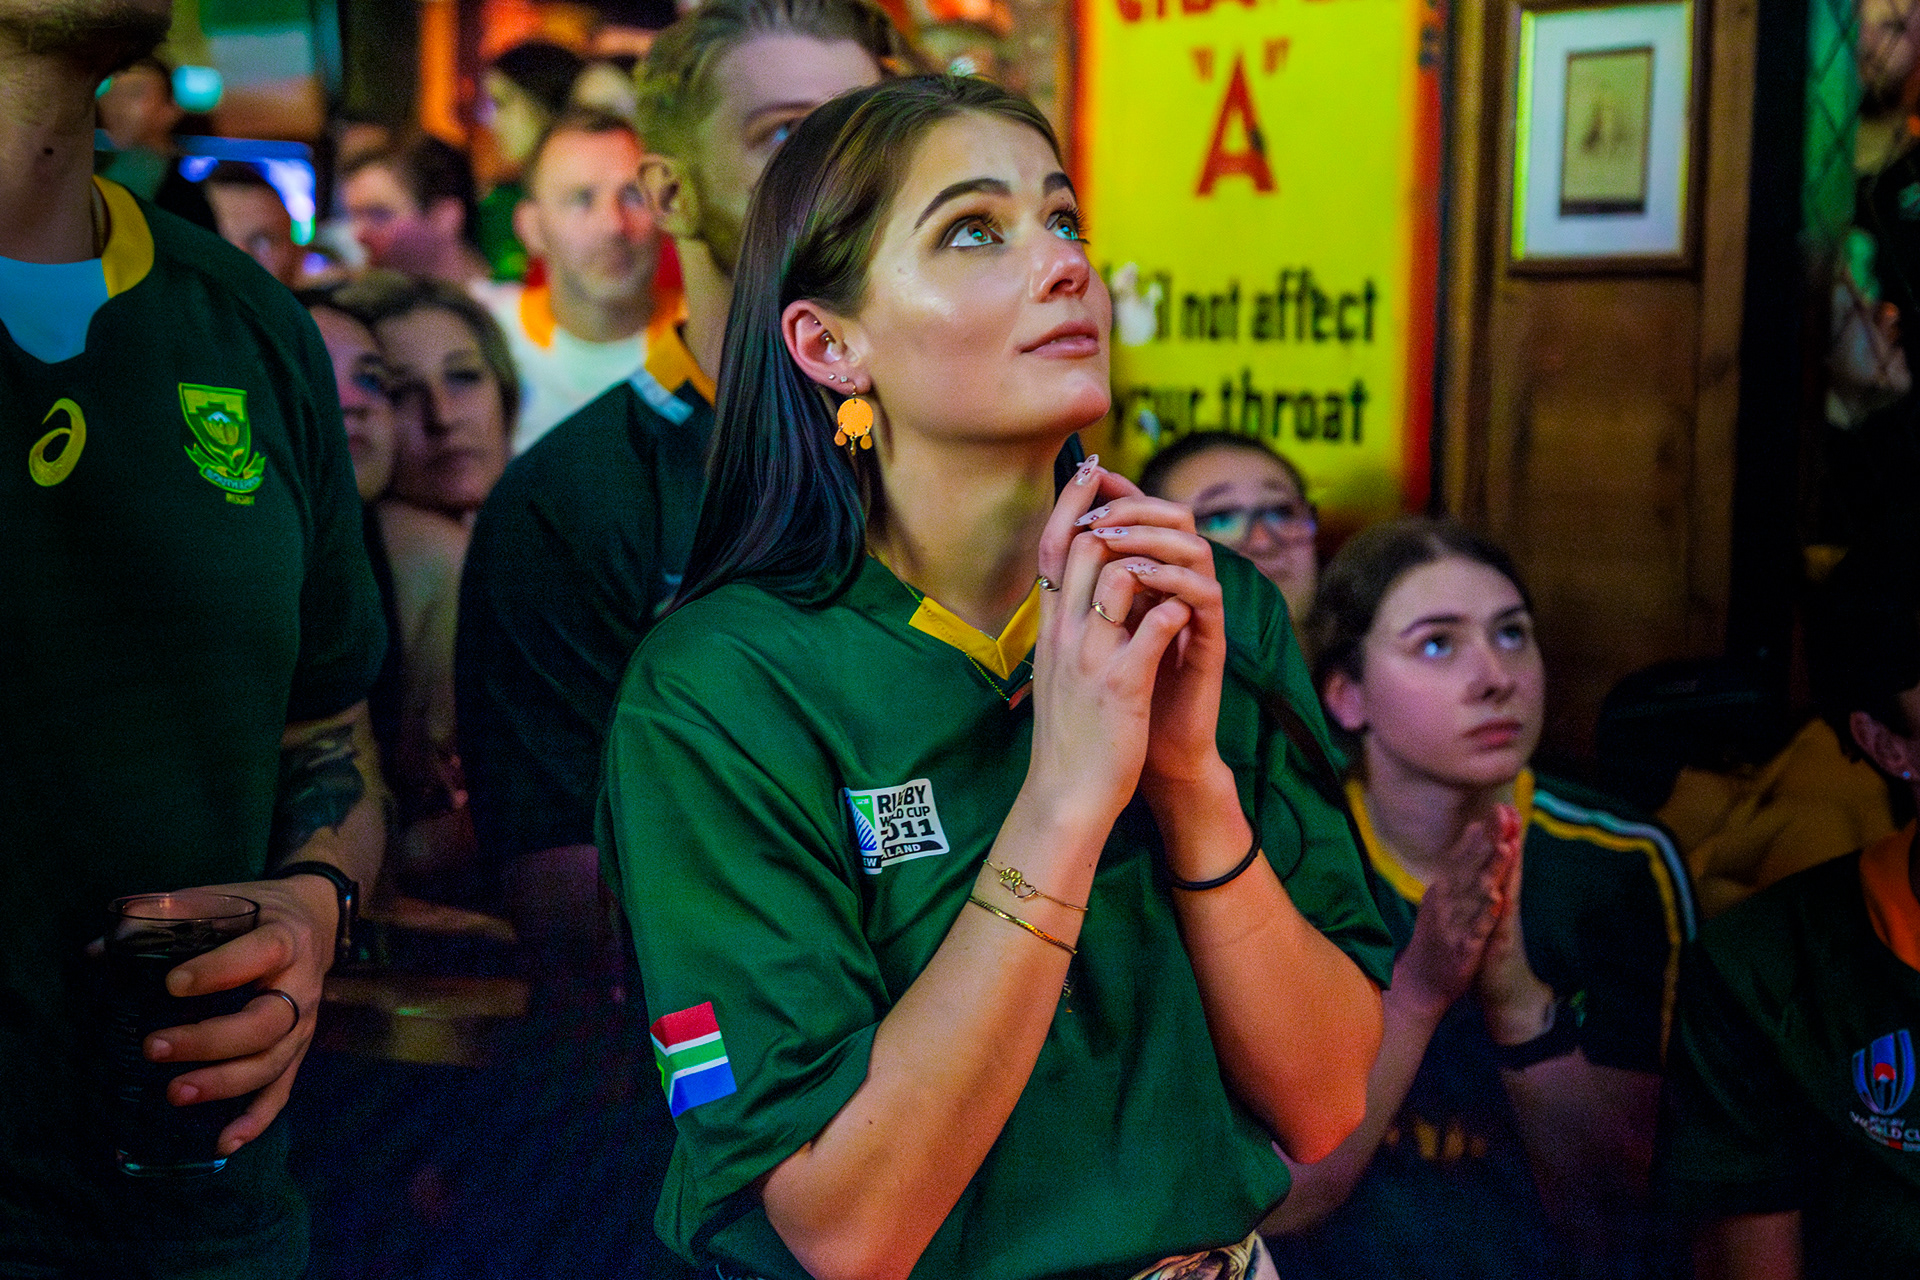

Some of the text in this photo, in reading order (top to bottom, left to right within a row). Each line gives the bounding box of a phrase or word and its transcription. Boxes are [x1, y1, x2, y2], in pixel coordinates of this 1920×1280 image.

[1180, 279, 1239, 342] not
[1252, 265, 1376, 343] affect
[1220, 370, 1366, 444] throat
[906, 805, 931, 818] CUP
